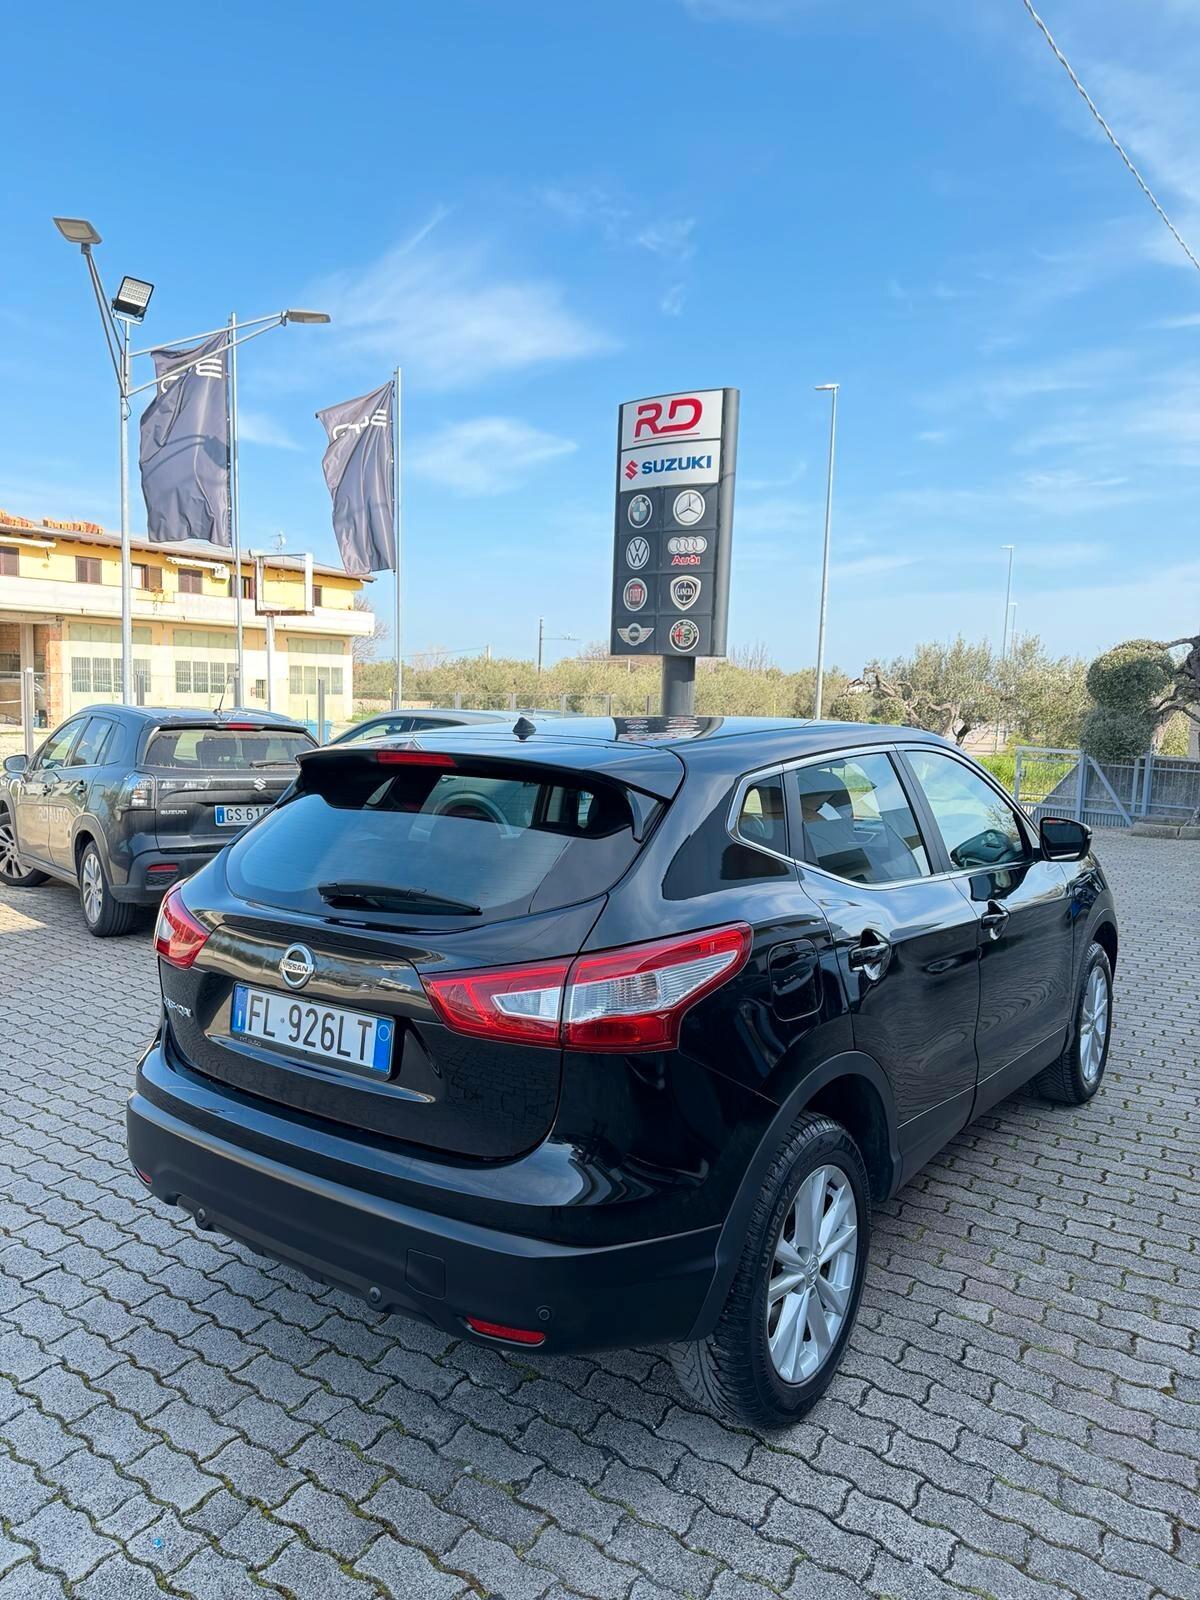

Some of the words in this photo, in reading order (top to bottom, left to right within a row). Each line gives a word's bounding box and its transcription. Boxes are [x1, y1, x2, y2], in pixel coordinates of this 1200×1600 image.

[634, 398, 703, 438] RD
[641, 455, 712, 475] SUZUKI
[671, 555, 700, 566] Audi
[226, 808, 241, 821] GS
[281, 960, 309, 972] NISSAN
[248, 994, 275, 1038] FL
[288, 1003, 373, 1061] 926LT
